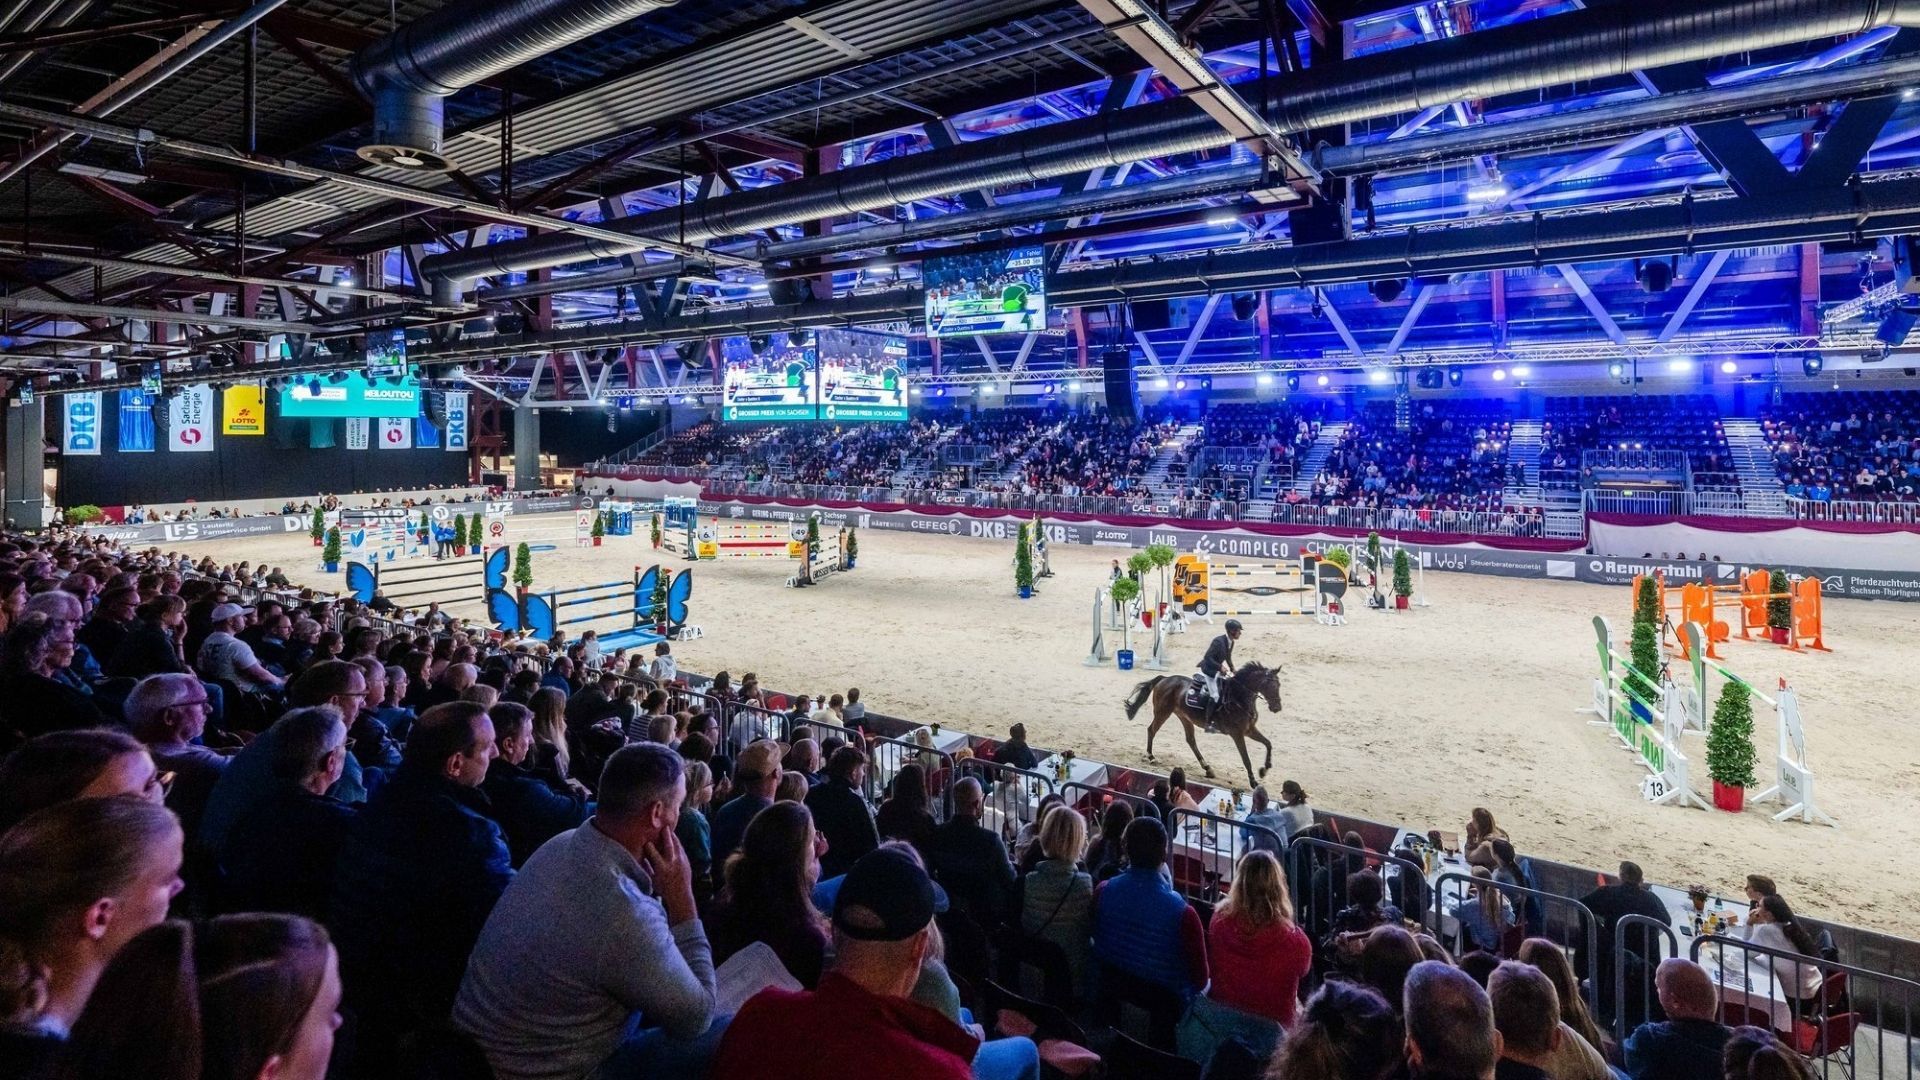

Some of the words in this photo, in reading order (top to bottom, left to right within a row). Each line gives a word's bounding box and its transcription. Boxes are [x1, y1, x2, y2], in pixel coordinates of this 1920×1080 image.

[182, 390, 190, 424] Sachsen
[192, 392, 201, 424] Energie
[738, 408, 760, 416] GROSSER
[70, 402, 95, 450] DKB
[450, 410, 464, 446] DKB
[202, 527, 248, 536] Farmservice
[284, 516, 314, 532] DK
[911, 520, 948, 530] CEFEG
[970, 520, 1005, 538] DKB
[164, 524, 199, 541] LFS
[1041, 525, 1066, 542] KB
[1104, 532, 1126, 540] LOTTO
[1150, 530, 1177, 546] LAUB
[1220, 538, 1288, 557] COMPLEO
[1850, 586, 1920, 598] Sachsen-Thüringen
[1651, 782, 1663, 796] 13
